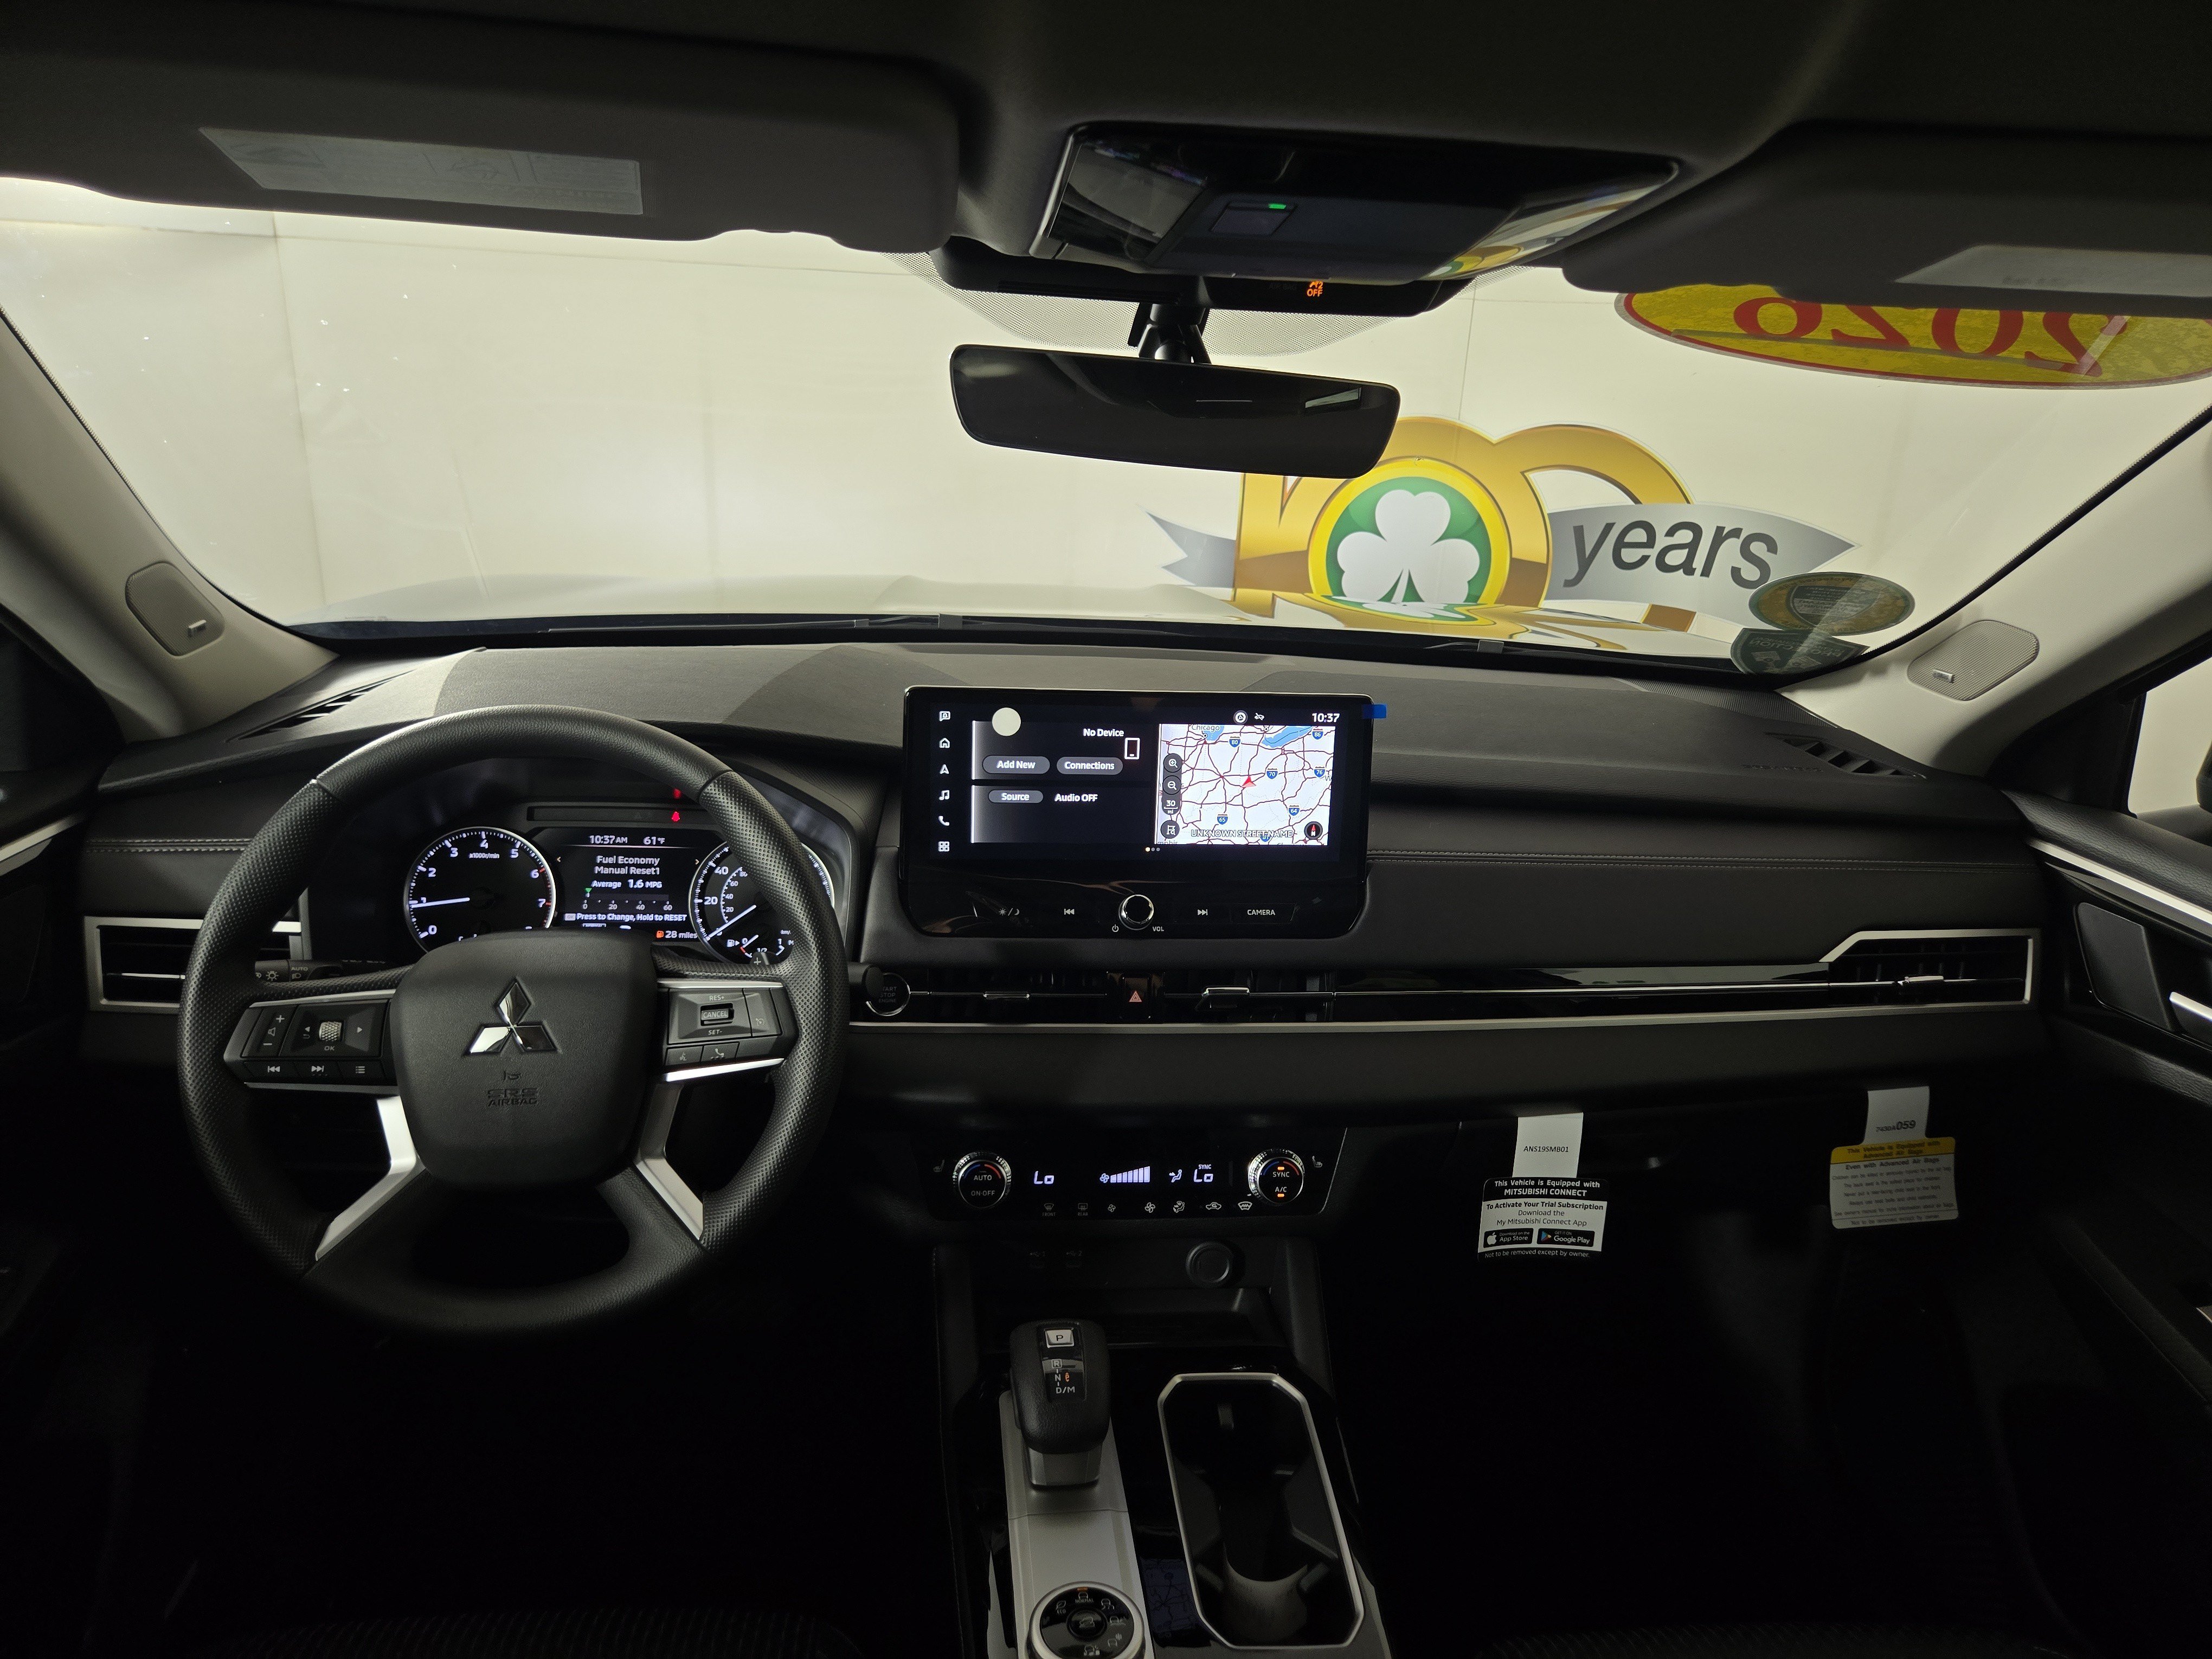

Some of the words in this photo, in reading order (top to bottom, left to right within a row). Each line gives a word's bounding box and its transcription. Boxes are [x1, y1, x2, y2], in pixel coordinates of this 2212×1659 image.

[1307, 288, 1323, 297] OFF
[1564, 520, 1780, 590] years
[1312, 713, 1340, 723] 10:37
[997, 761, 1015, 769] Add
[1016, 761, 1036, 769] New
[1064, 761, 1115, 770] Connections
[1001, 793, 1030, 801] Source
[1054, 794, 1080, 802] Audio
[1081, 794, 1098, 802] OFF
[480, 840, 488, 848] 4
[450, 847, 458, 857] 3
[510, 848, 518, 858] 5
[596, 856, 616, 864] Fuel
[618, 856, 660, 866] Economy
[428, 867, 436, 877] 2
[530, 870, 539, 878] 6
[594, 866, 628, 874] Manual
[715, 866, 729, 875] 40
[591, 880, 621, 889] Average
[628, 879, 644, 888] 1.6
[538, 898, 545, 908] 7
[704, 896, 718, 905] 20
[607, 914, 636, 922] Change,
[428, 925, 437, 935] 0
[665, 930, 677, 938] 28
[702, 1010, 728, 1018] CANCEL
[488, 1097, 538, 1107] AIRBAG
[1033, 1171, 1054, 1184] Lo
[1193, 1169, 1213, 1182] Lo
[1558, 1202, 1603, 1210] Subscription
